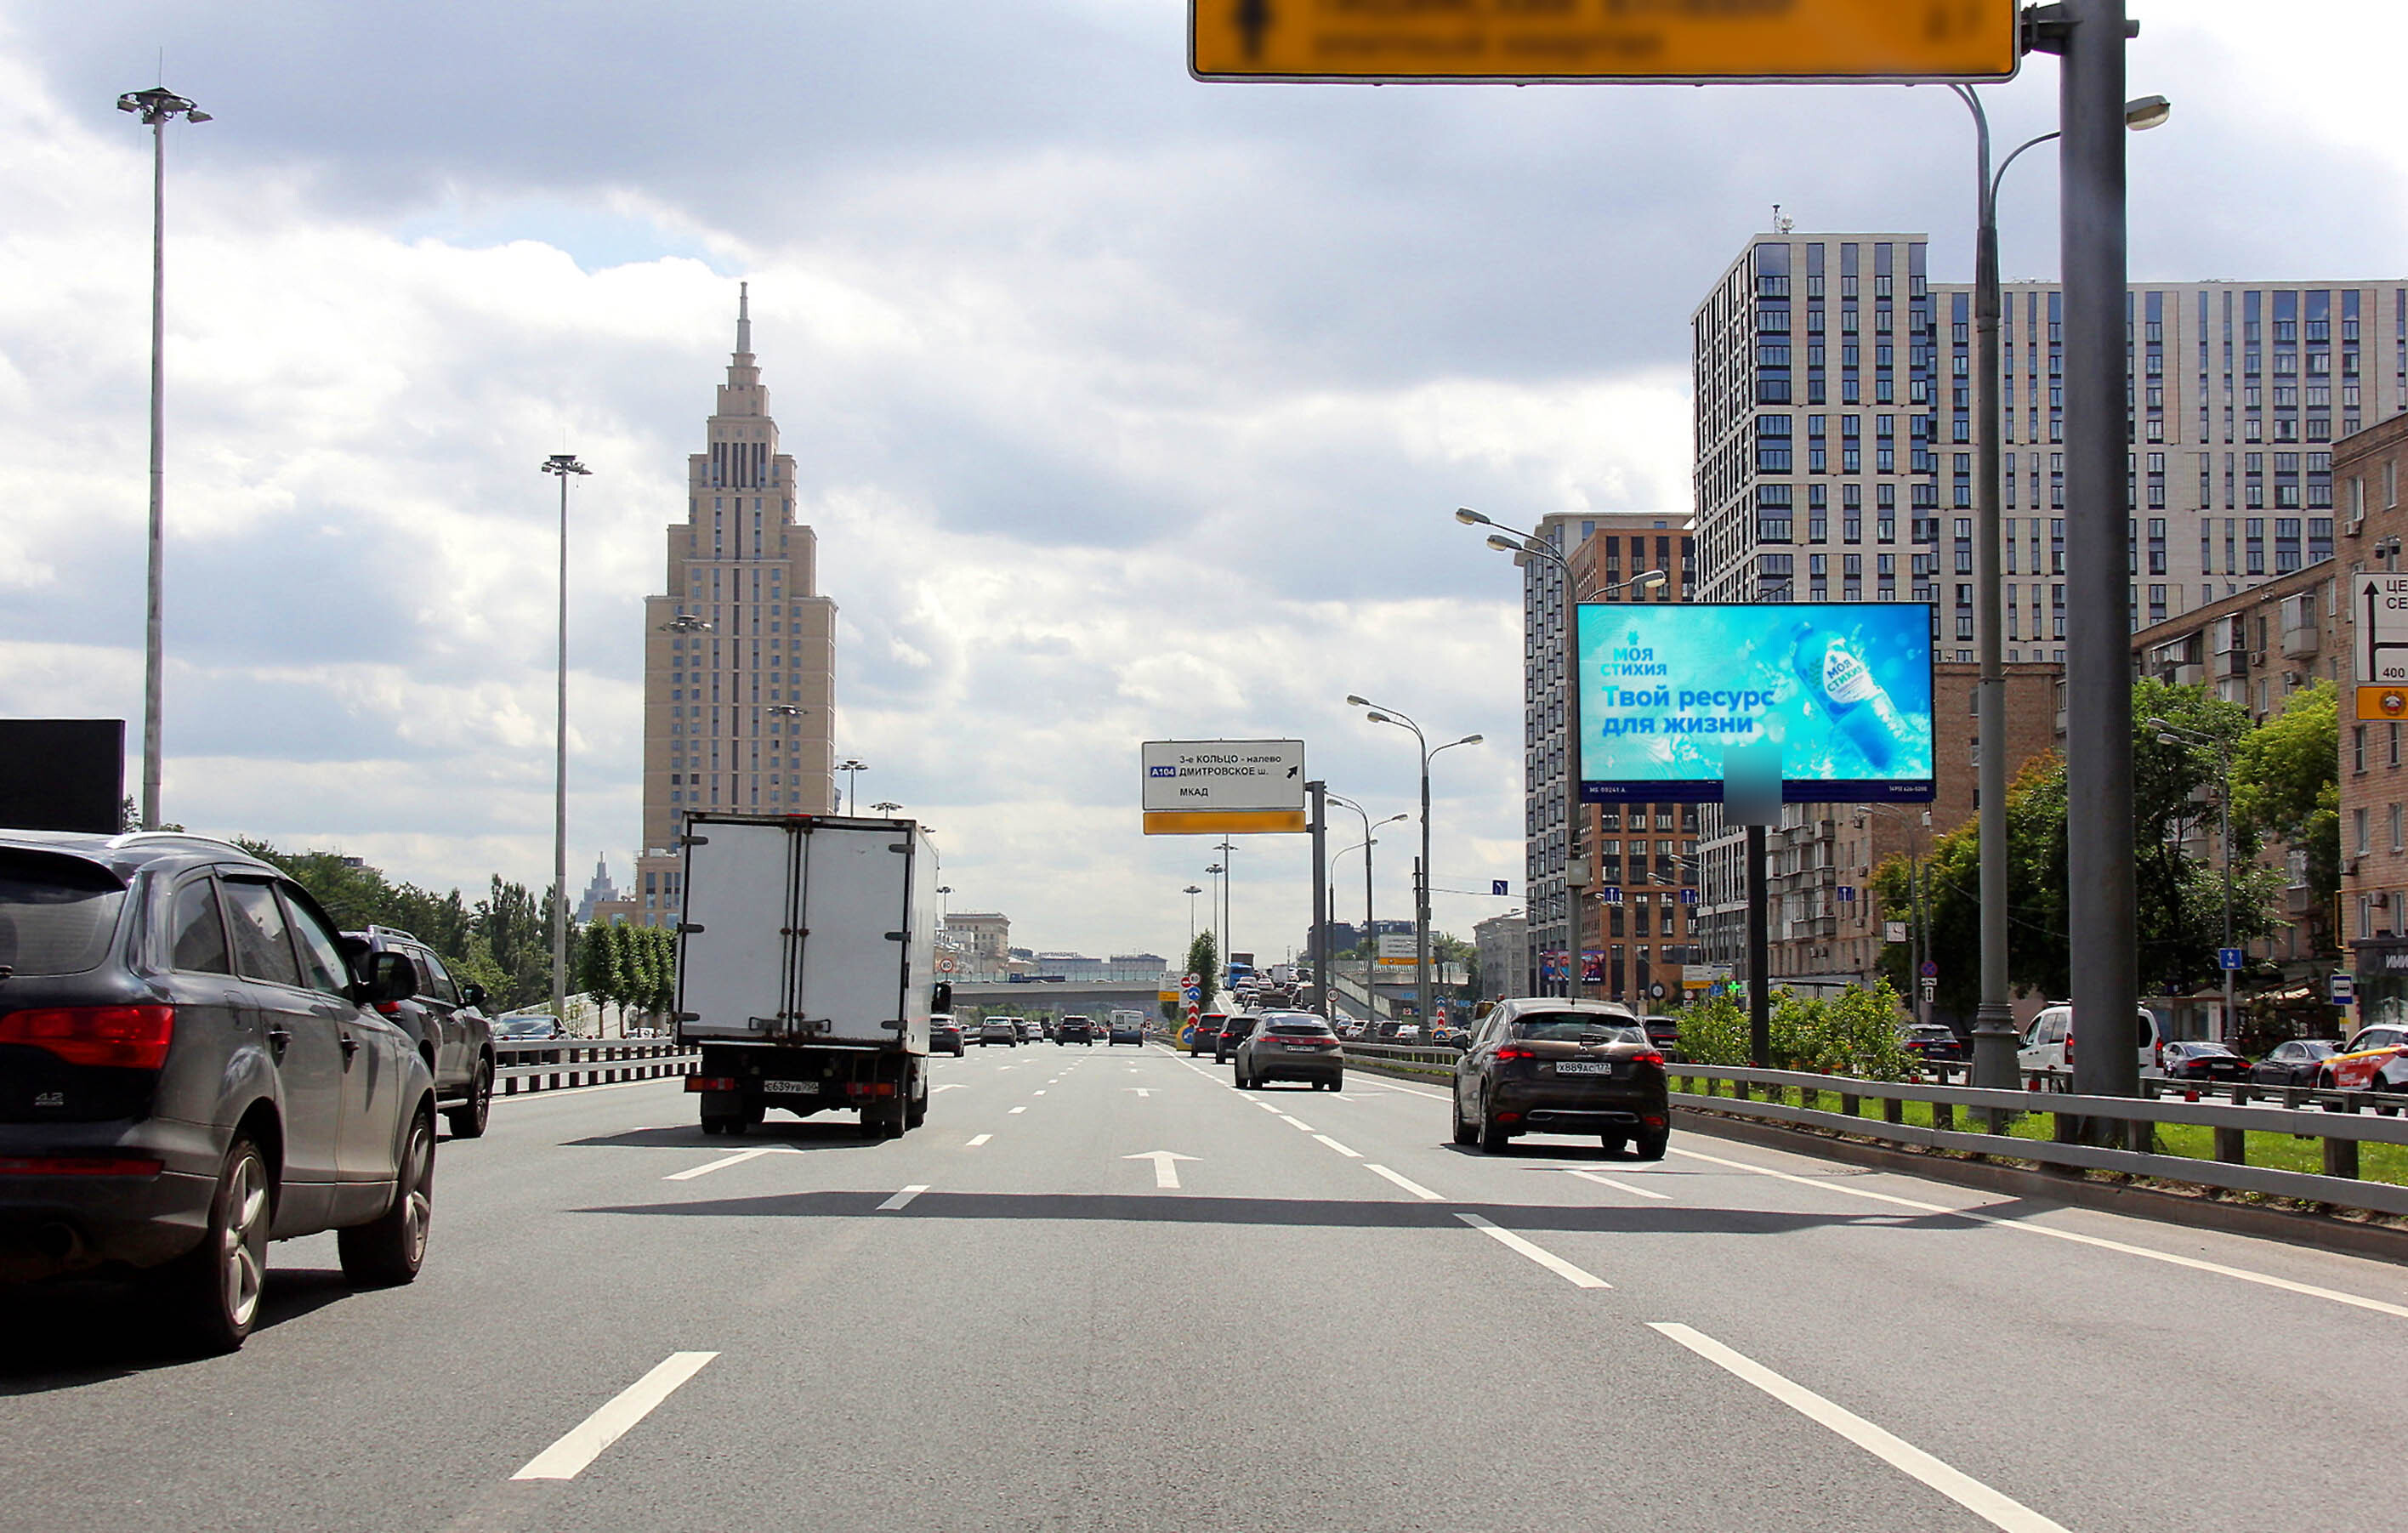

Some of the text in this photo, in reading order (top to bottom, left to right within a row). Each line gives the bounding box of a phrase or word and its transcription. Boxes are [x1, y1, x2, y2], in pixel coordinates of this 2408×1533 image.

[2387, 580, 2408, 593] ЦЕ
[2387, 597, 2408, 610] СЕ
[1613, 647, 1654, 661] МОЯ
[1600, 663, 1667, 676] СТИХИЯ
[1826, 659, 1852, 679] МОЯ
[2382, 667, 2405, 678] 400
[1601, 684, 1775, 712] Твой ресурс
[1602, 718, 1753, 736] для жизни
[1196, 754, 1239, 764] КОЛЬЦО
[1247, 755, 1282, 764] налево
[1179, 767, 1255, 777] ДМИТРОВСКОЕ
[1179, 787, 1209, 798] МКАД
